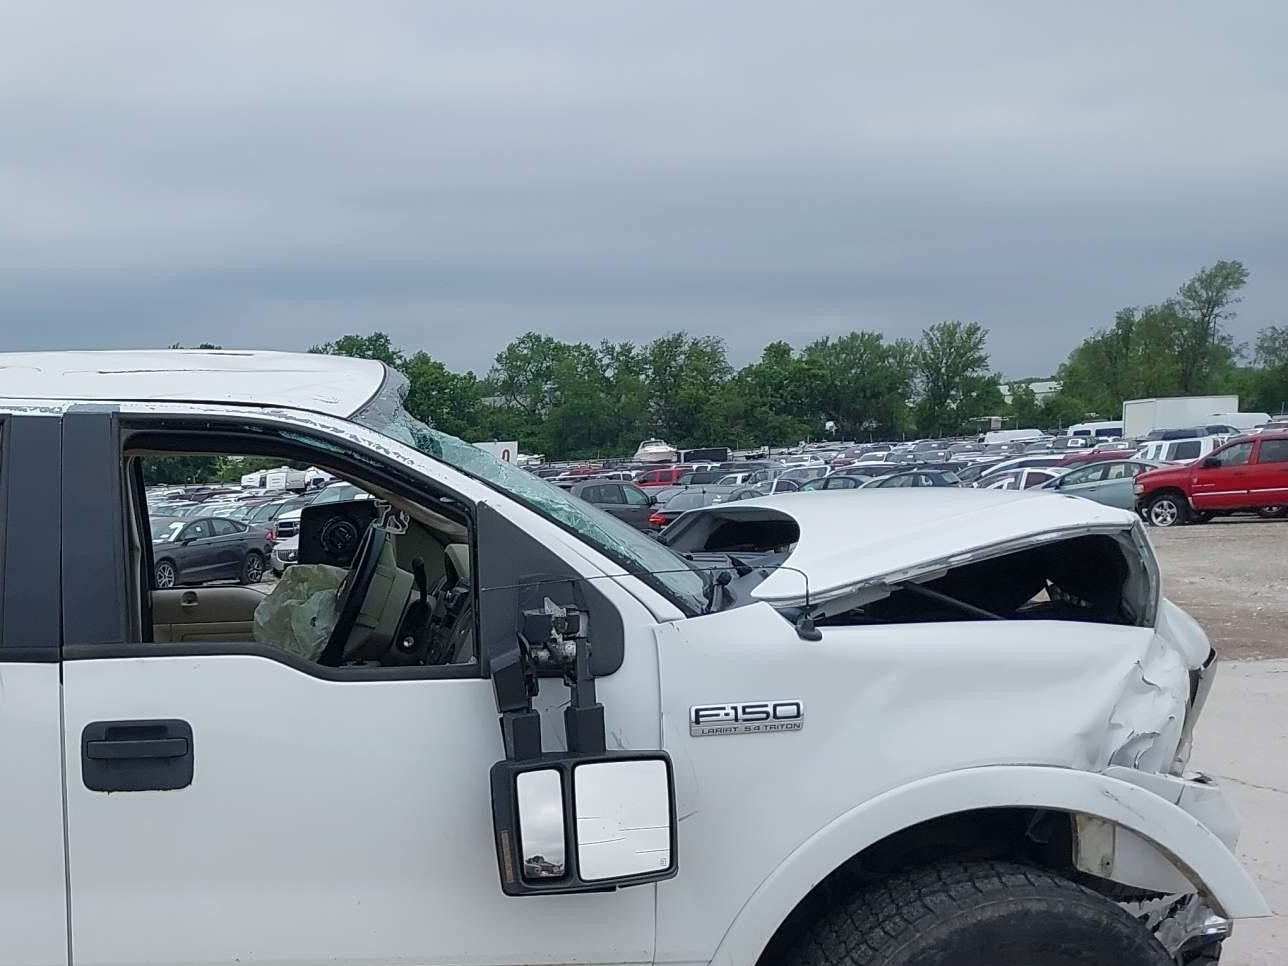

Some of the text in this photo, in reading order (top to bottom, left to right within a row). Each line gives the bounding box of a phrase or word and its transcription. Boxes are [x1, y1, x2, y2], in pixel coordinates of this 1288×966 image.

[694, 701, 801, 725] F-150
[701, 726, 739, 736] LARIAT
[763, 721, 801, 732] TRITON
